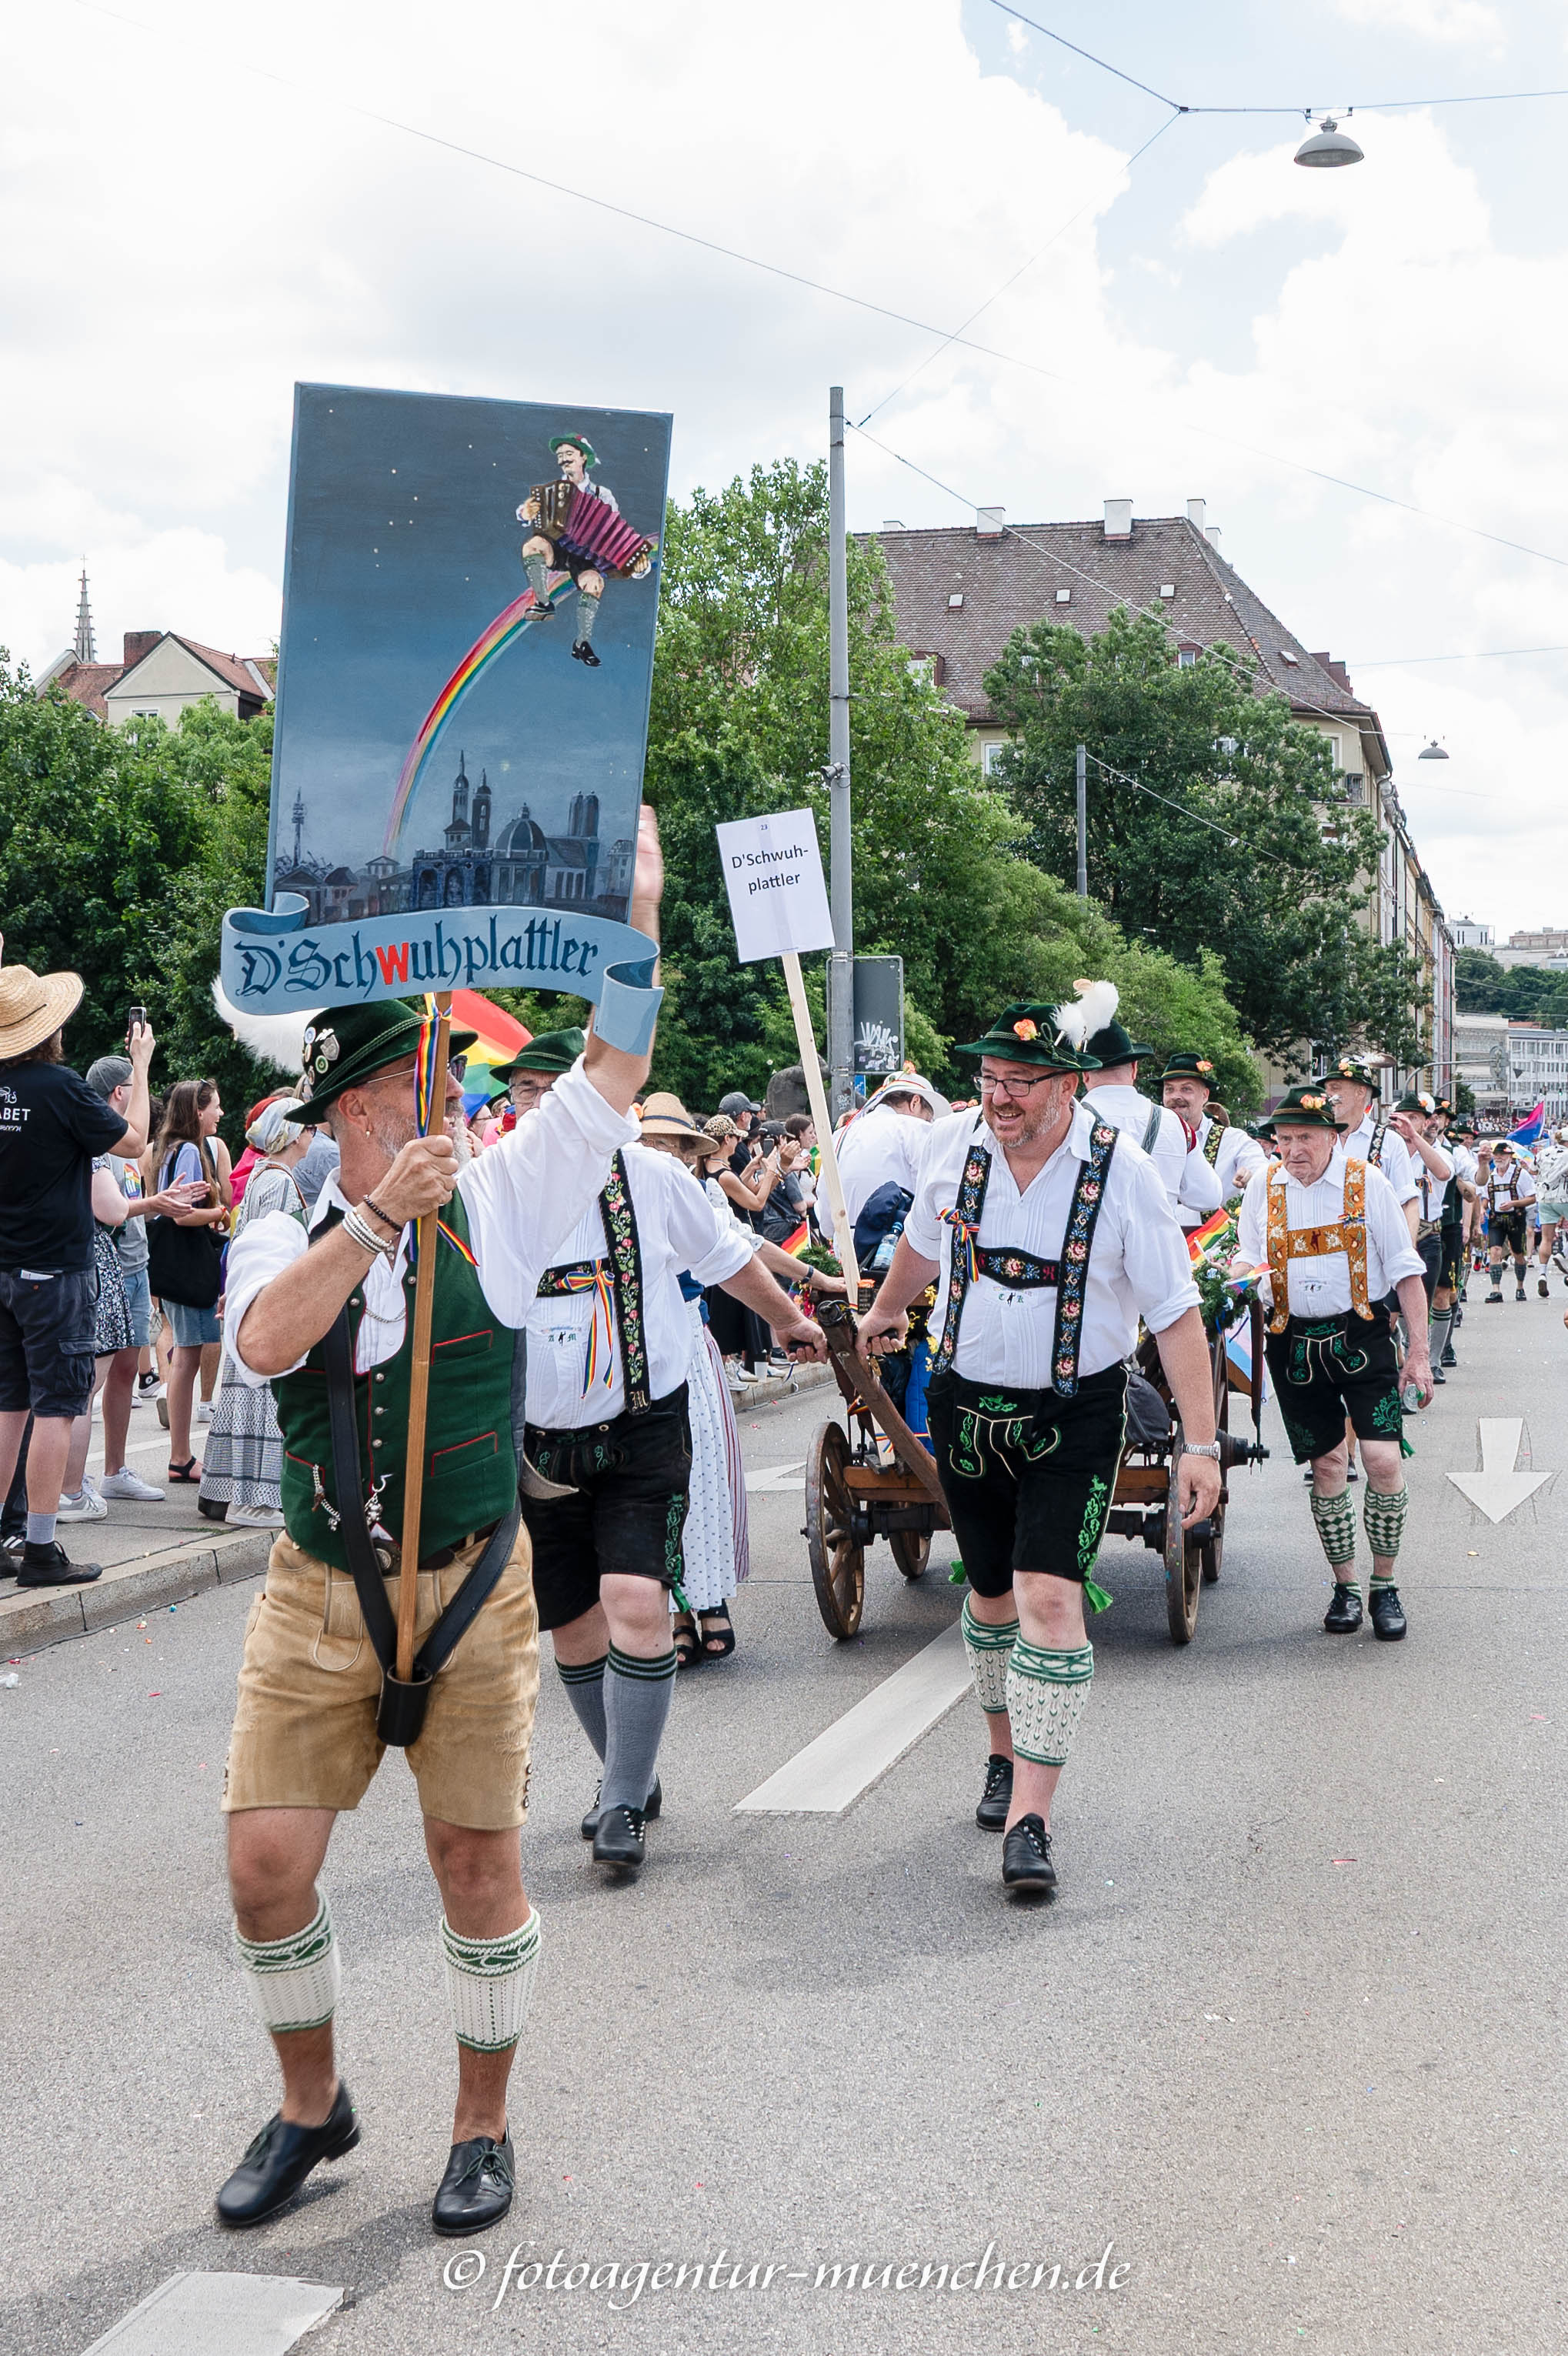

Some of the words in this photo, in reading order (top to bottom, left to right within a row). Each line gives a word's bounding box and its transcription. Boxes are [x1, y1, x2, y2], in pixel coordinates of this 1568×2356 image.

[732, 845, 809, 868] D'Schwuh-
[749, 873, 800, 895] plattler
[234, 914, 598, 999] D'Schwuhplattler
